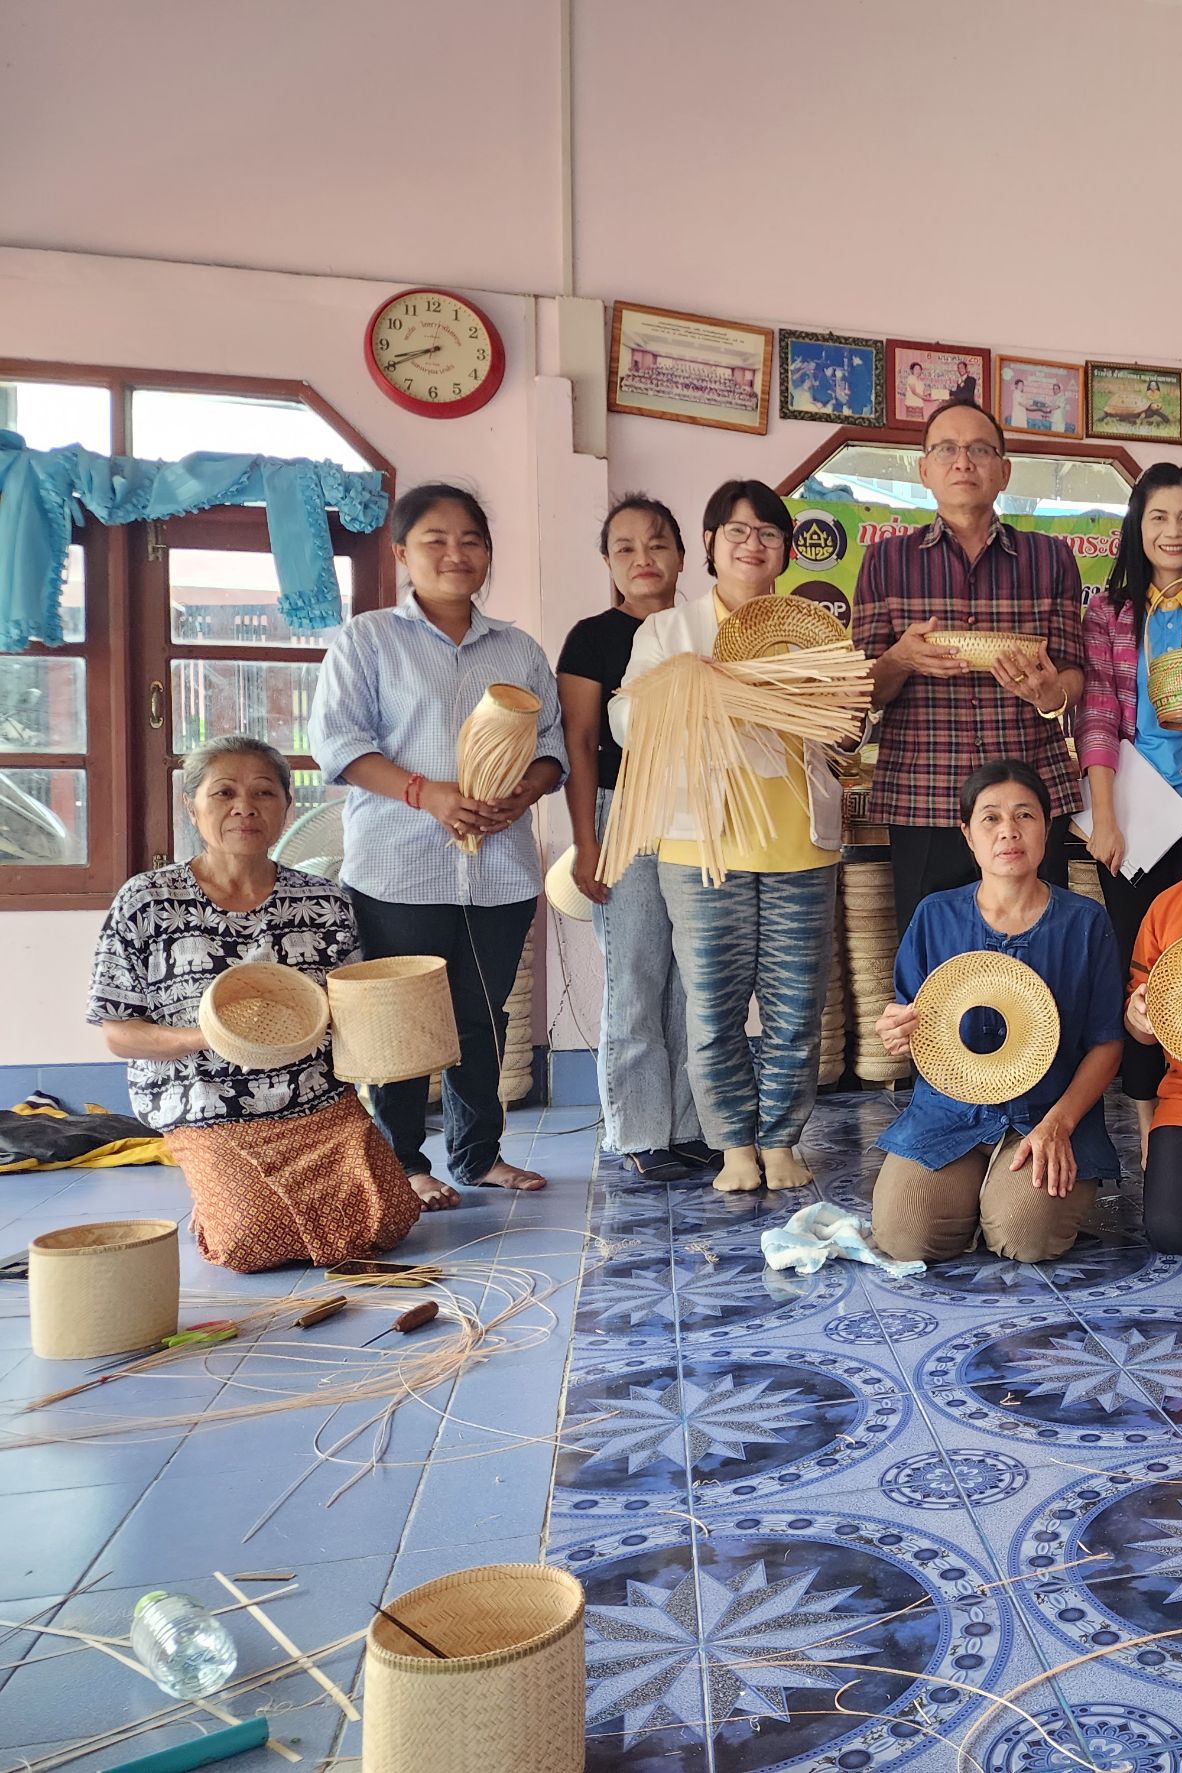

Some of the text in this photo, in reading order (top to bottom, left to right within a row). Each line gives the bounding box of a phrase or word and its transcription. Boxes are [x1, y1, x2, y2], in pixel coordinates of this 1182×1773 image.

[404, 304, 417, 317] 11
[426, 300, 441, 313] 12
[453, 309, 460, 321] 1
[388, 318, 402, 330] 10
[469, 327, 478, 339] 2
[379, 339, 390, 351] 9
[477, 349, 486, 361] 3
[388, 360, 397, 372] 8
[468, 368, 479, 380] 4
[404, 378, 413, 391] 7
[452, 383, 462, 395] 5
[428, 386, 438, 399] 6
